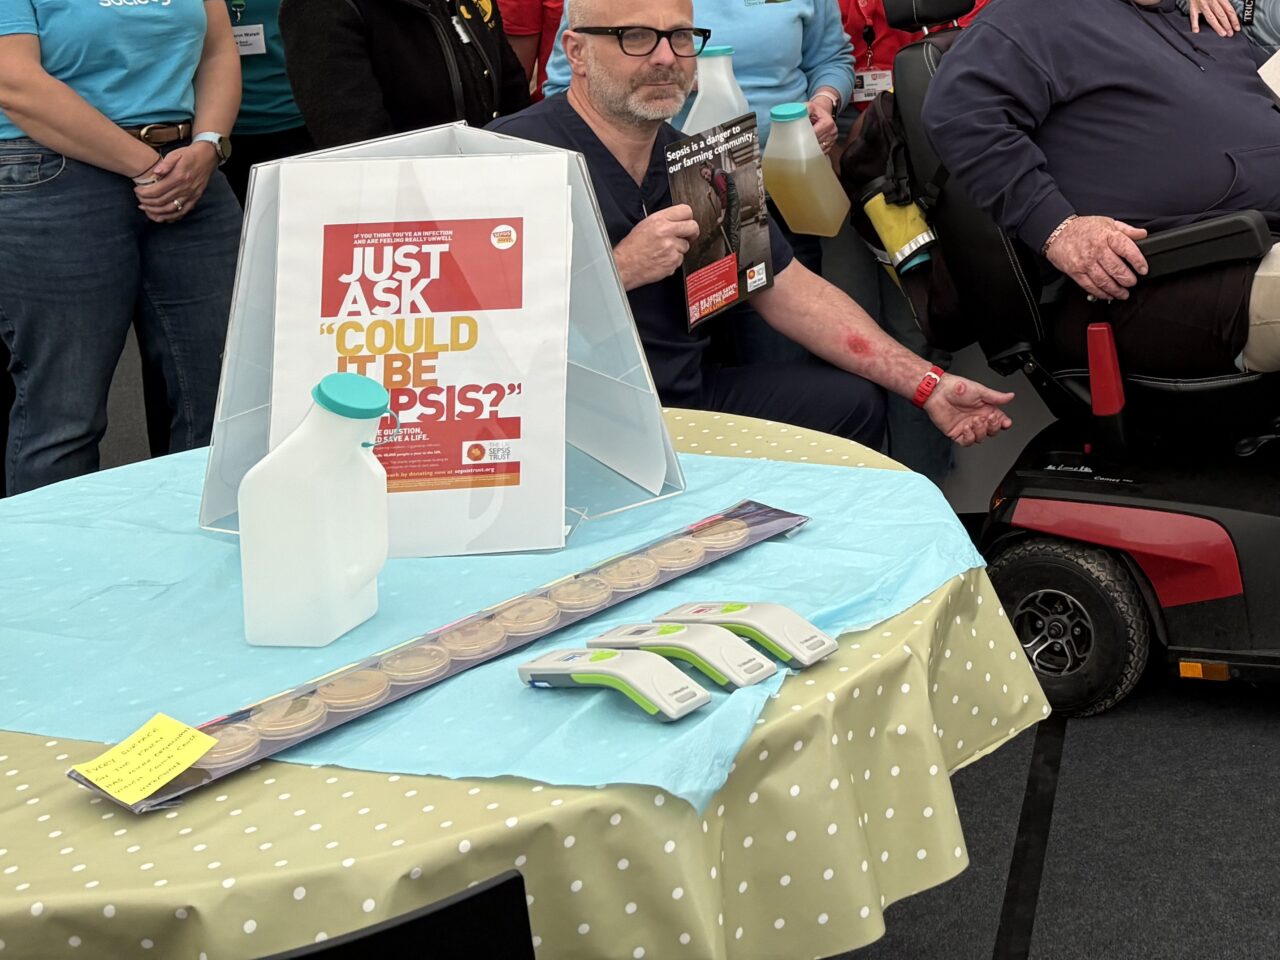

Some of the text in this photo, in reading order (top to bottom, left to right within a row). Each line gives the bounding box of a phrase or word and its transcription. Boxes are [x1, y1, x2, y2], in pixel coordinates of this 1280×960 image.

[666, 145, 691, 163] Sepsis
[691, 142, 698, 152] is
[706, 130, 730, 147] danger
[732, 125, 741, 134] to
[668, 132, 755, 174] our farming community.
[338, 243, 449, 283] JUST
[337, 277, 432, 317] ASK
[319, 315, 478, 356] “COULD
[338, 352, 439, 389] IT BE
[388, 382, 522, 424] PSIS?”
[383, 427, 423, 435] QUSTION,
[410, 433, 430, 441] LIFE.
